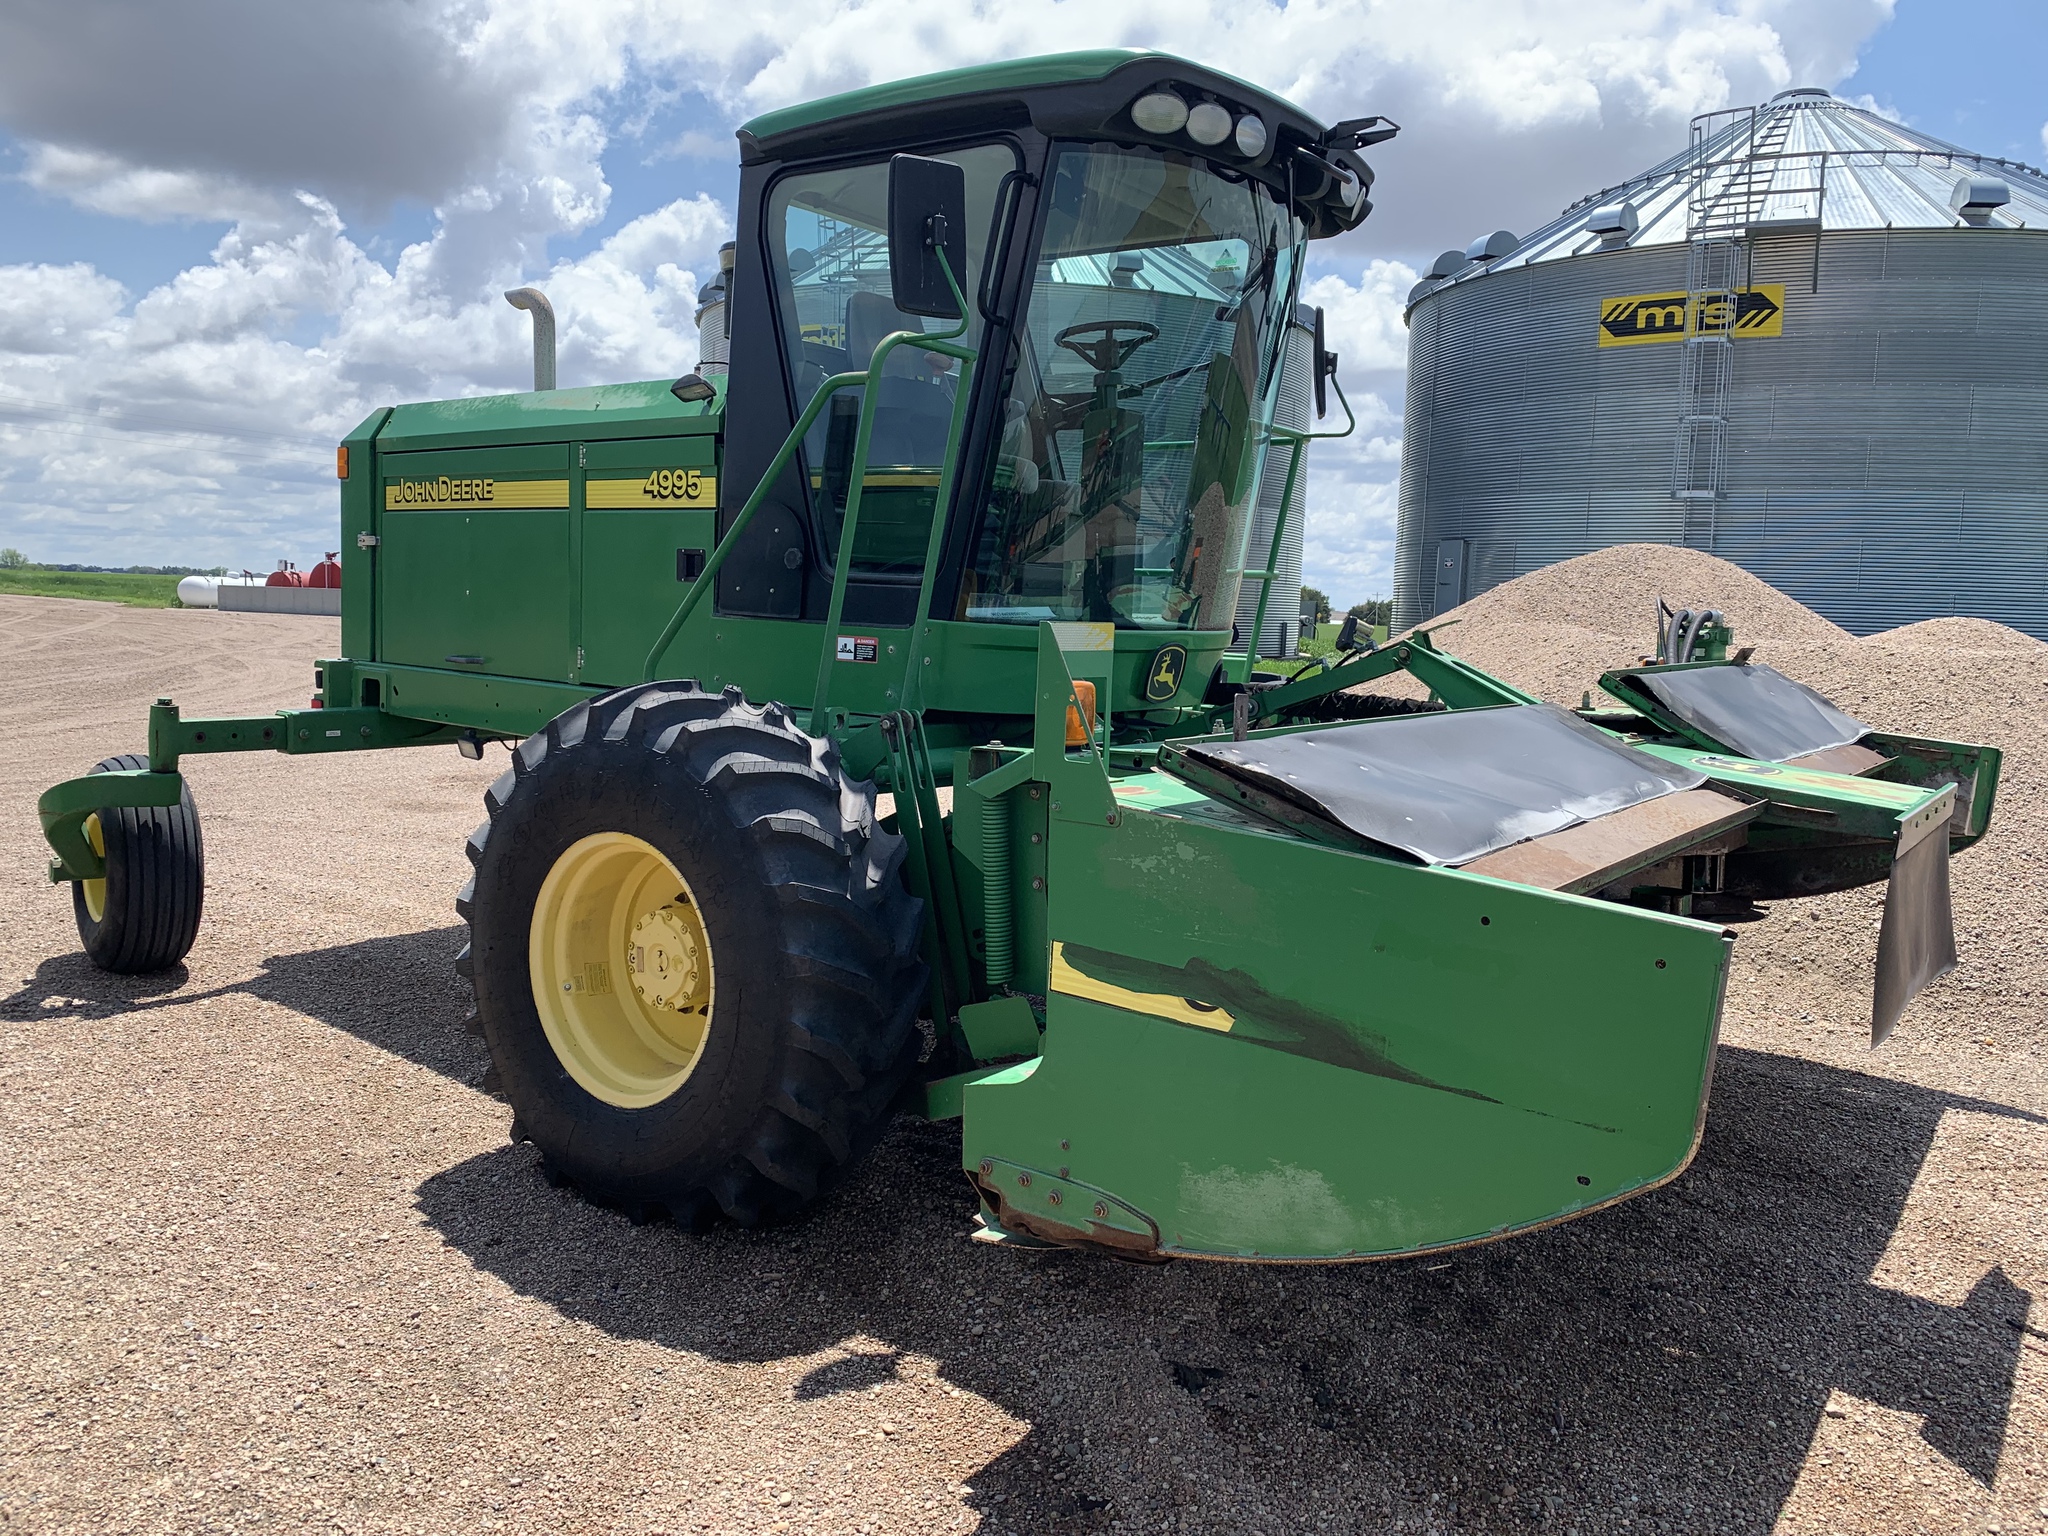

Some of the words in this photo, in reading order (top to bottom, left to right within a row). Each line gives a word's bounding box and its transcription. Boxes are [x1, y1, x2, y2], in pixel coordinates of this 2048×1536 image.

[395, 478, 436, 503] JOHN
[438, 476, 494, 501] DEERE
[644, 469, 702, 499] 4995
